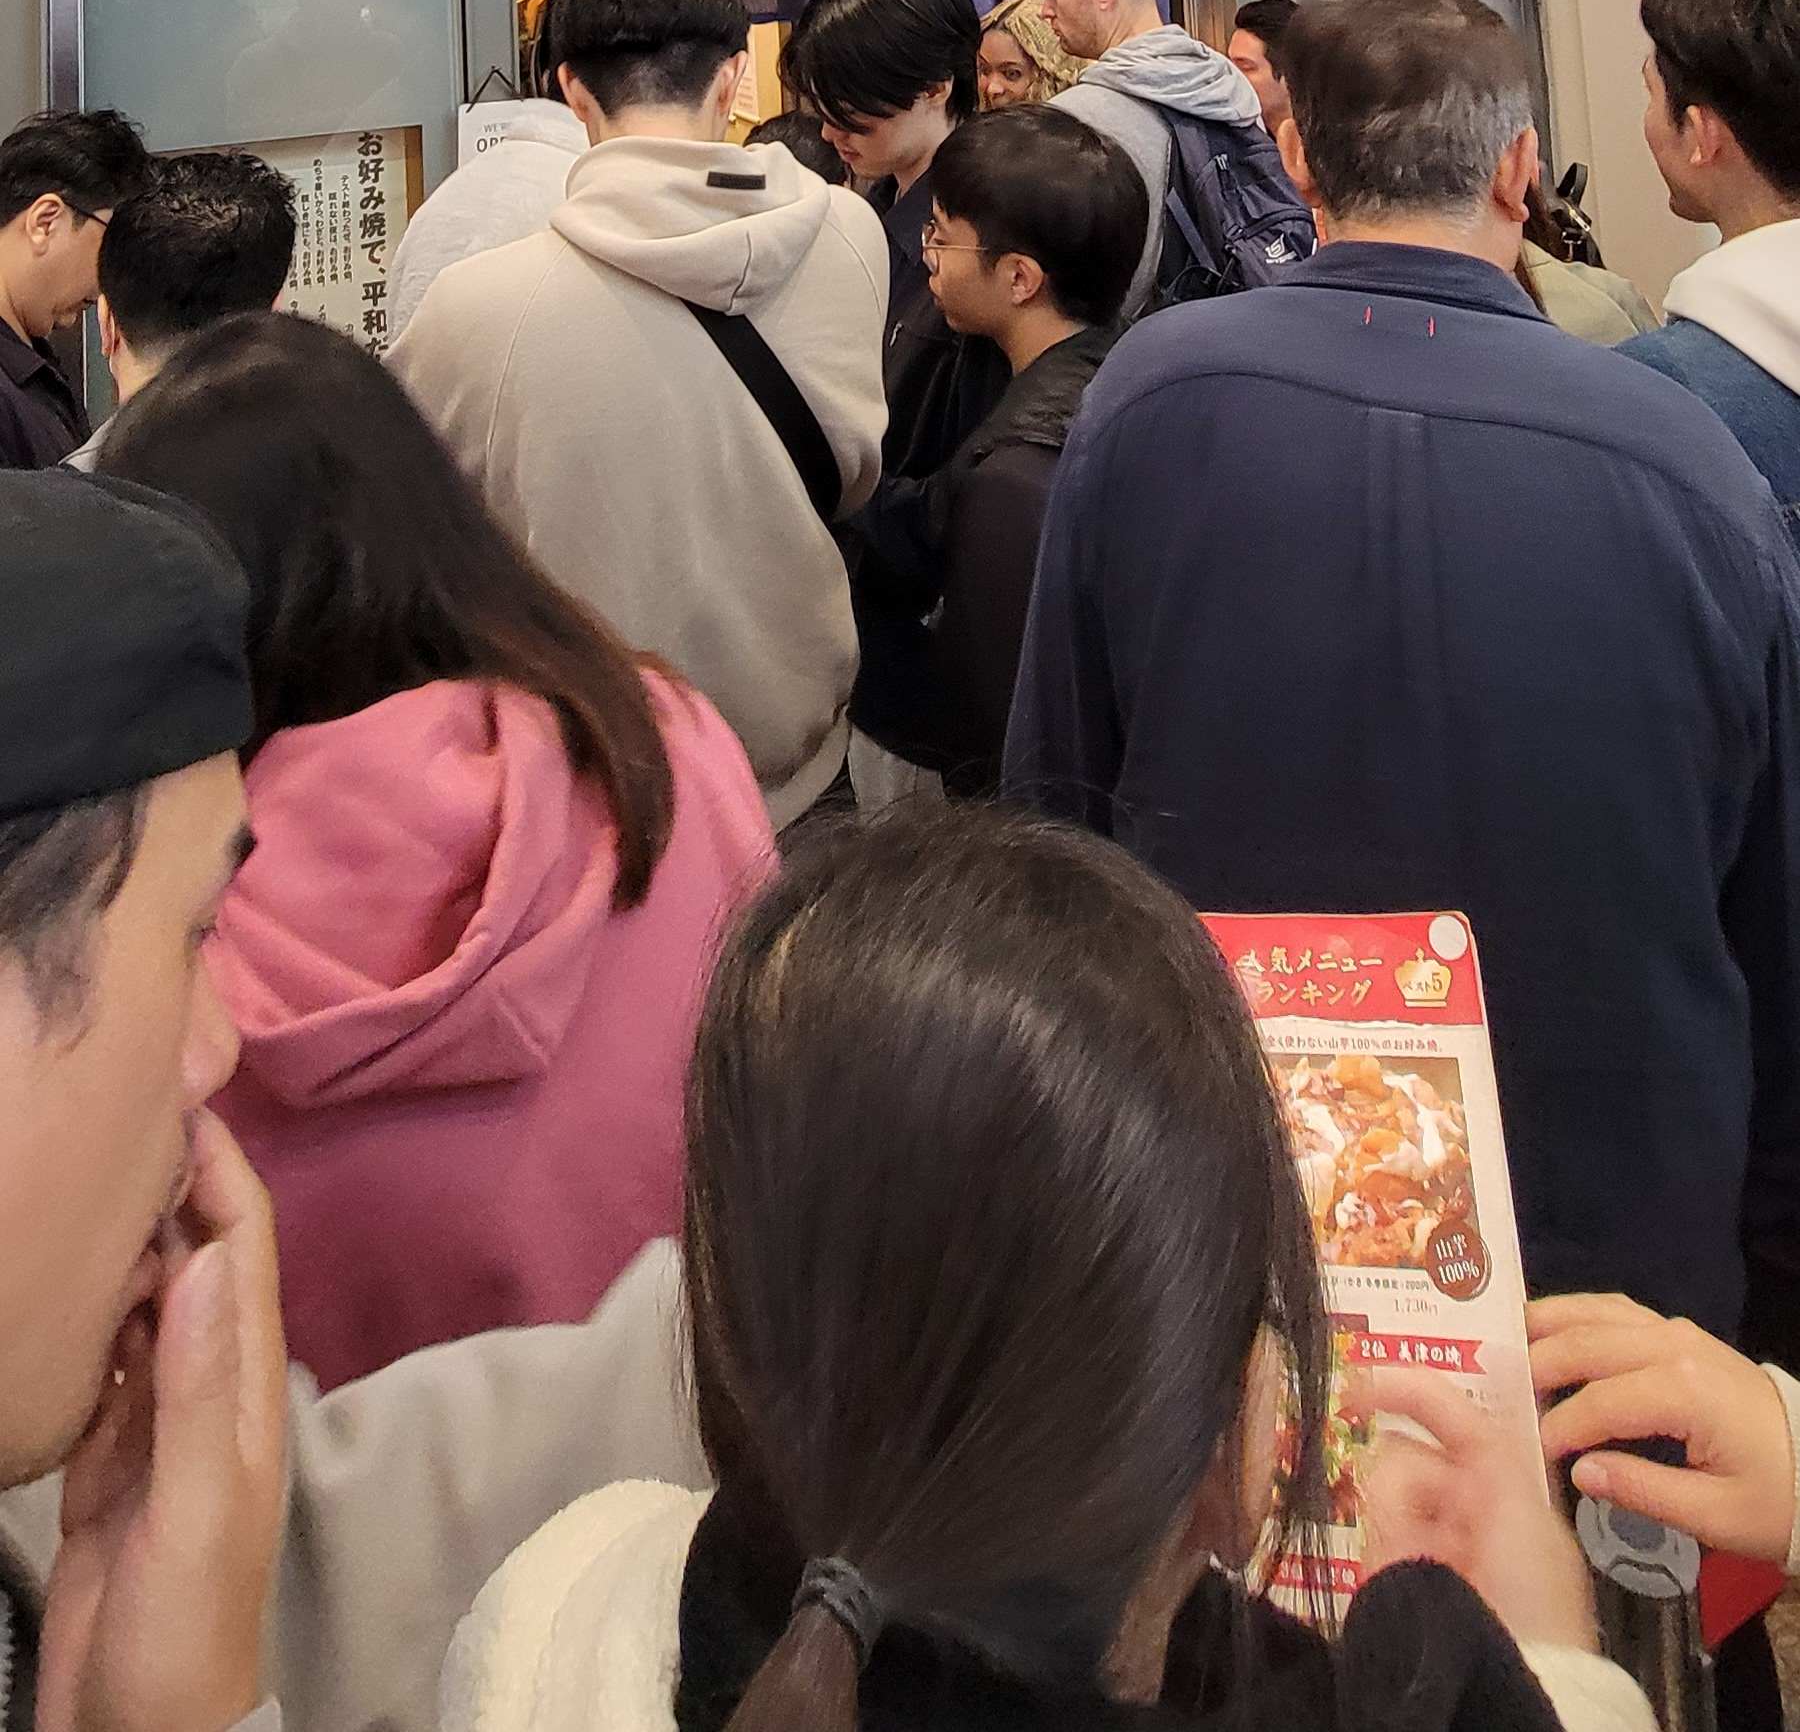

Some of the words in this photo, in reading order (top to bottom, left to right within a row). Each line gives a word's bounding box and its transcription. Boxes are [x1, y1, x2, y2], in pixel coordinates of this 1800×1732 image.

[1256, 979, 1372, 1006] ランキング
[1438, 1261, 1479, 1285] 100%
[1361, 1339, 1387, 1359] 2位
